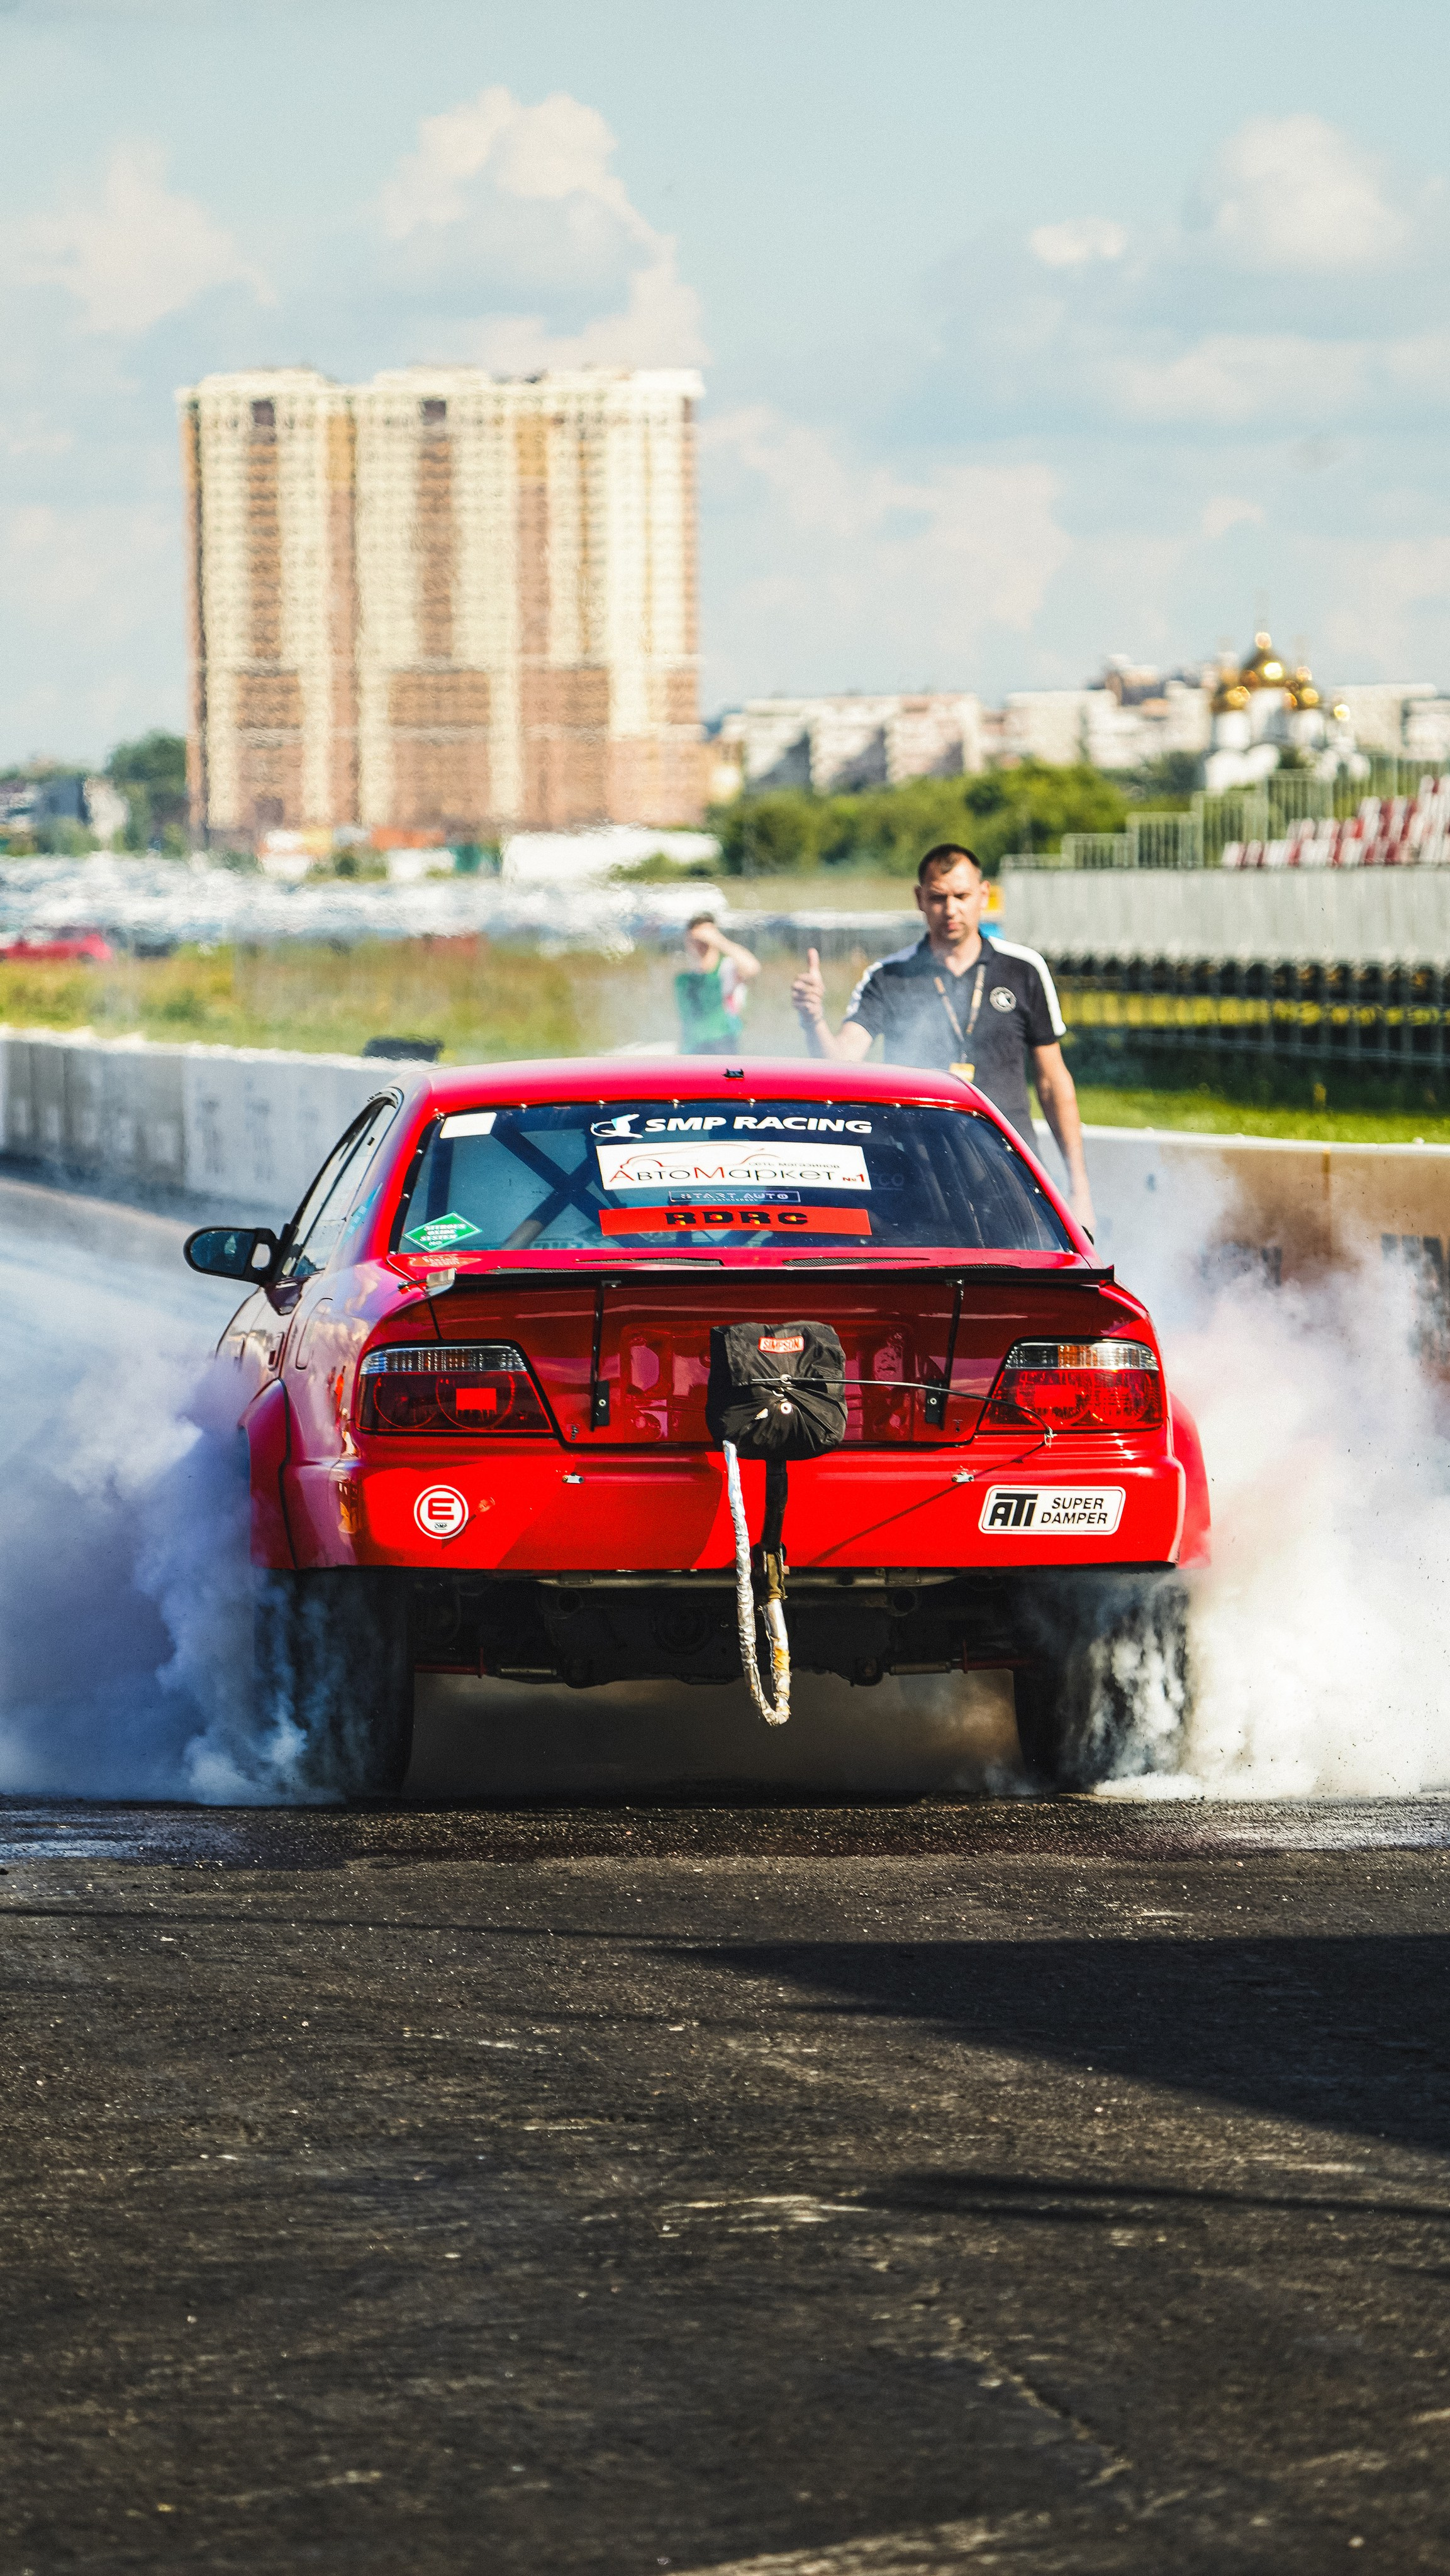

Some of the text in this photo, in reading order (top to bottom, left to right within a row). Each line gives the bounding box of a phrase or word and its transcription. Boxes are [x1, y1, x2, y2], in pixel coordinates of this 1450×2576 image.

[645, 1116, 873, 1134] SMP RACING
[664, 1211, 808, 1226] RDRC
[763, 1338, 800, 1350] SIMPSON
[988, 1493, 1039, 1526] ATI
[1052, 1497, 1104, 1509] SUPER
[1040, 1512, 1108, 1524] DAMPER
